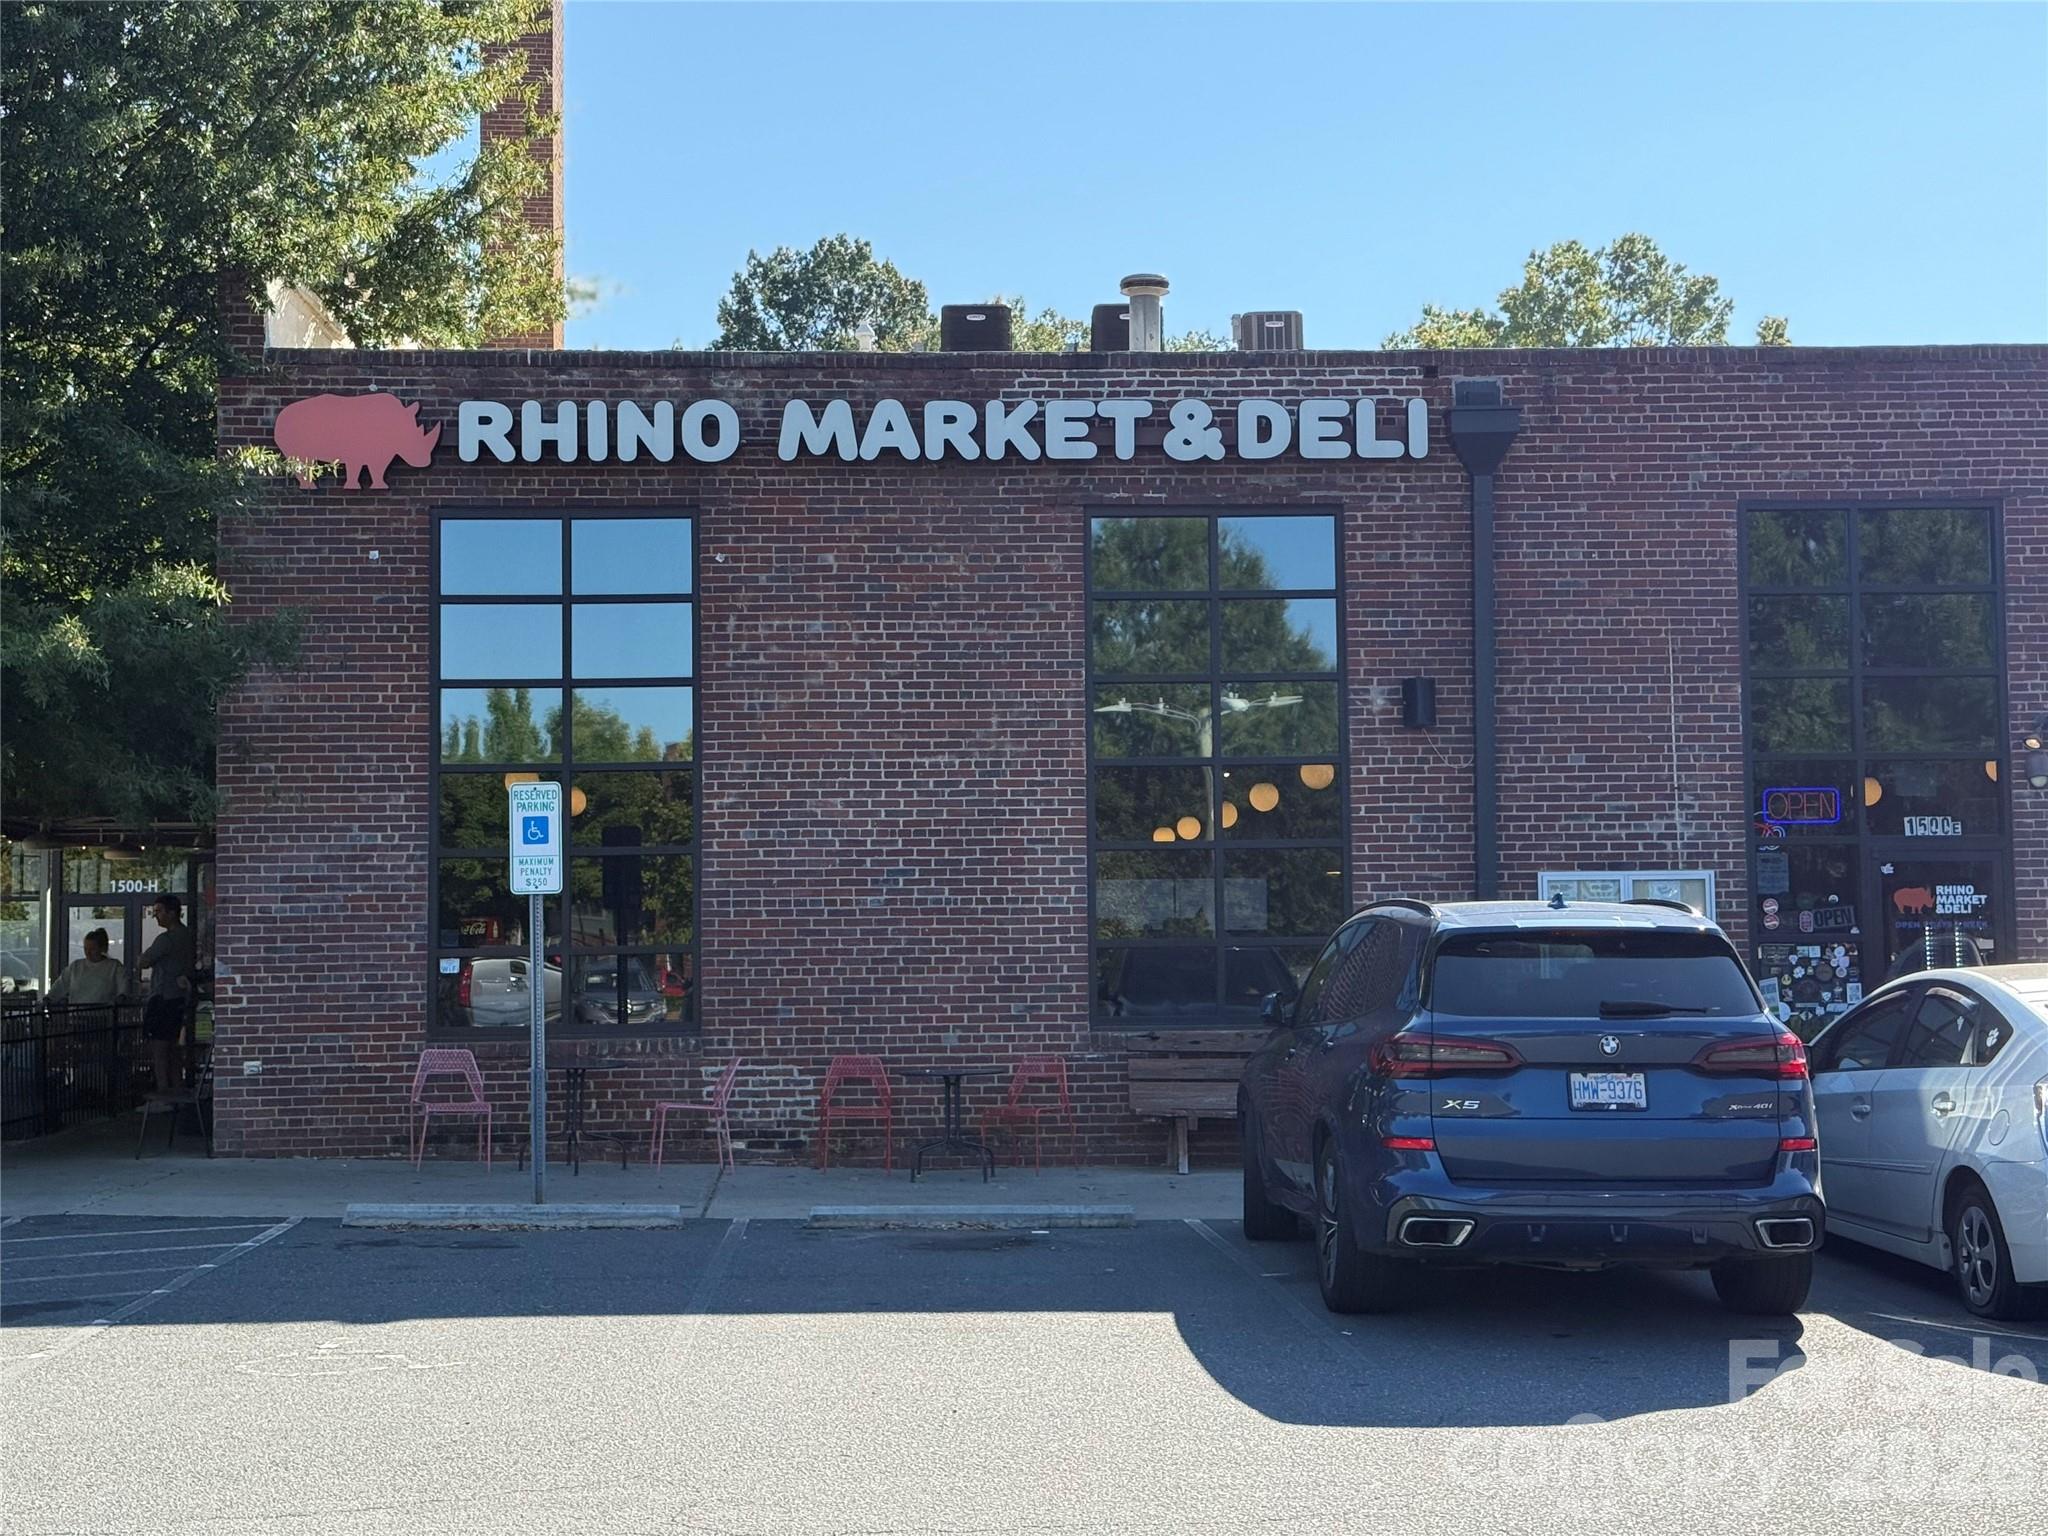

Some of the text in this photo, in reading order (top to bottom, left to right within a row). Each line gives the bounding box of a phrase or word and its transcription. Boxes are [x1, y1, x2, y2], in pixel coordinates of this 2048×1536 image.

[458, 398, 1428, 462] RHINO MARKET & DELI
[513, 789, 558, 800] RESERVED
[516, 802, 555, 812] PARKING
[1768, 792, 1835, 819] OPEN
[519, 858, 554, 866] MAXIMUM
[520, 868, 552, 876] PENALTY
[110, 880, 158, 893] 1500-H
[525, 878, 548, 887] $250
[1935, 885, 1975, 895] RHINO
[1935, 894, 1987, 904] MARKET
[1814, 907, 1853, 927] OPEN
[1573, 1080, 1643, 1100] HMW-9376
[1442, 1099, 1480, 1110] X5
